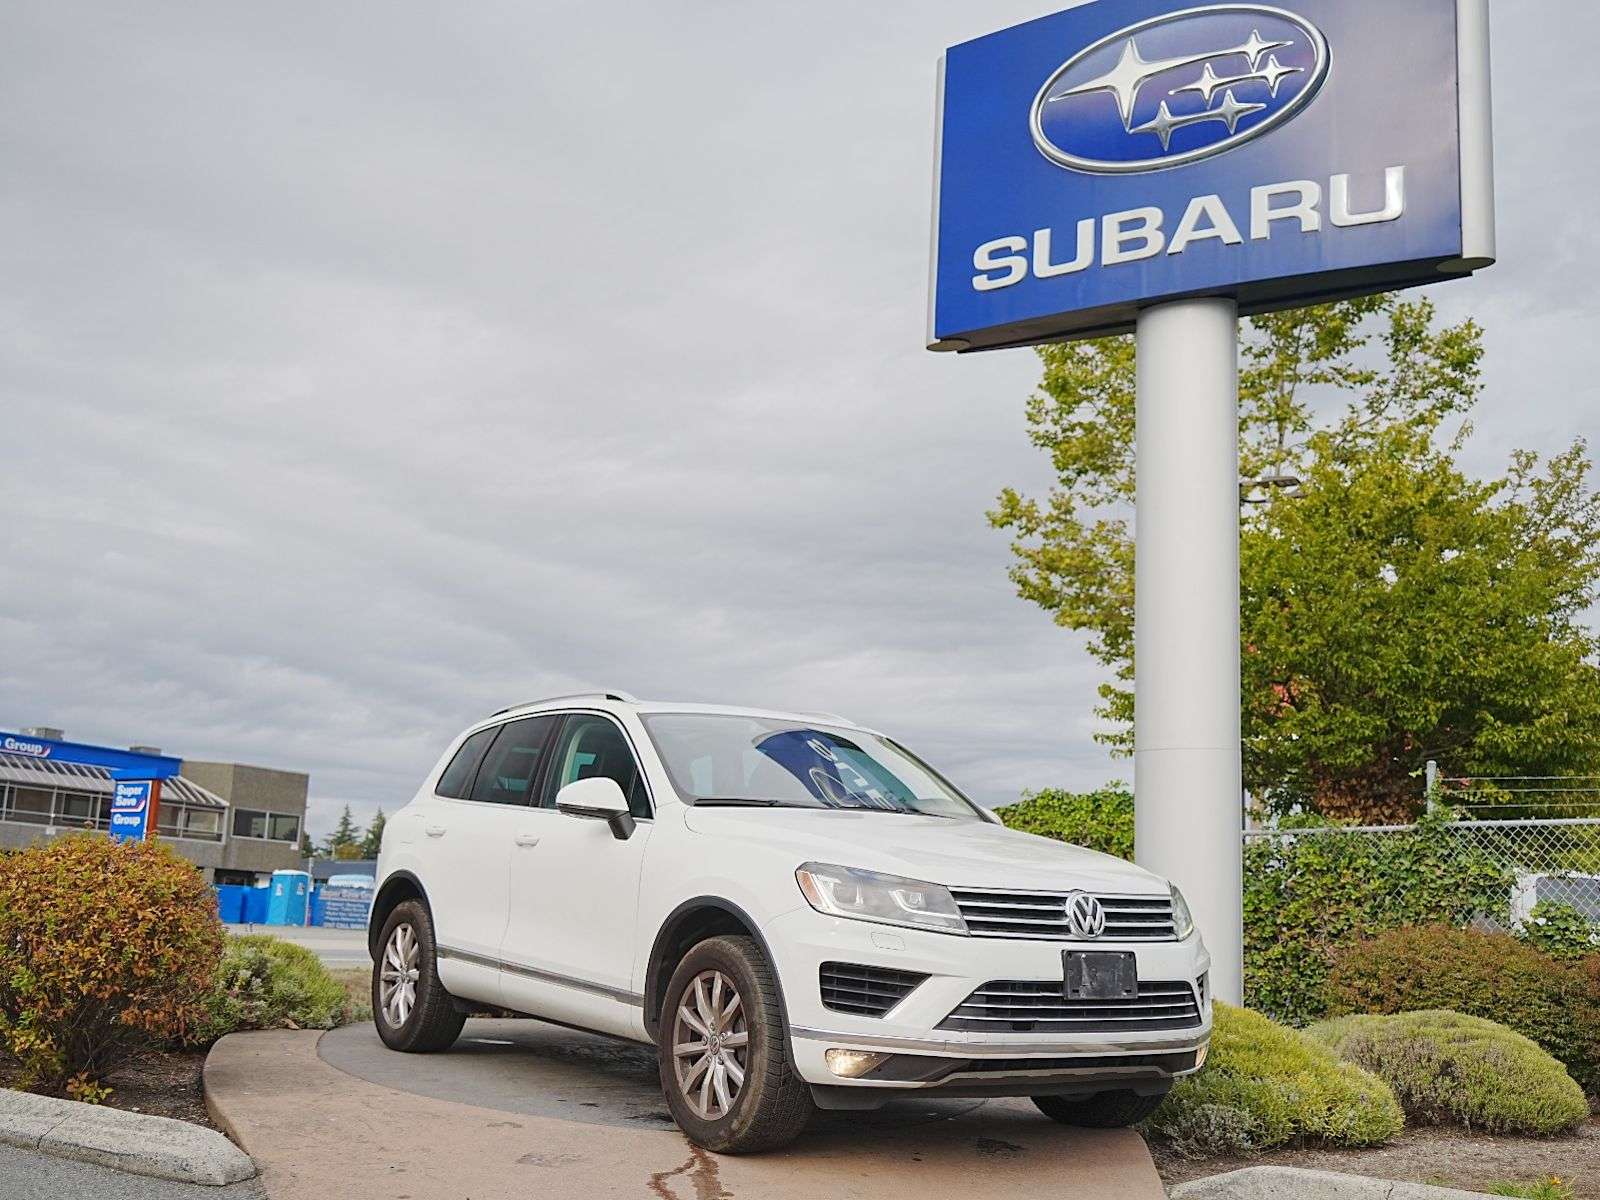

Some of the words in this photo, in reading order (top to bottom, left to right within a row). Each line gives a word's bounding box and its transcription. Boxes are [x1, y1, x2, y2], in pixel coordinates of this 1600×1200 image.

[971, 165, 1406, 292] SUBARU
[5, 737, 43, 754] Group
[116, 784, 143, 797] Super
[115, 795, 137, 807] Save
[113, 813, 141, 827] Group
